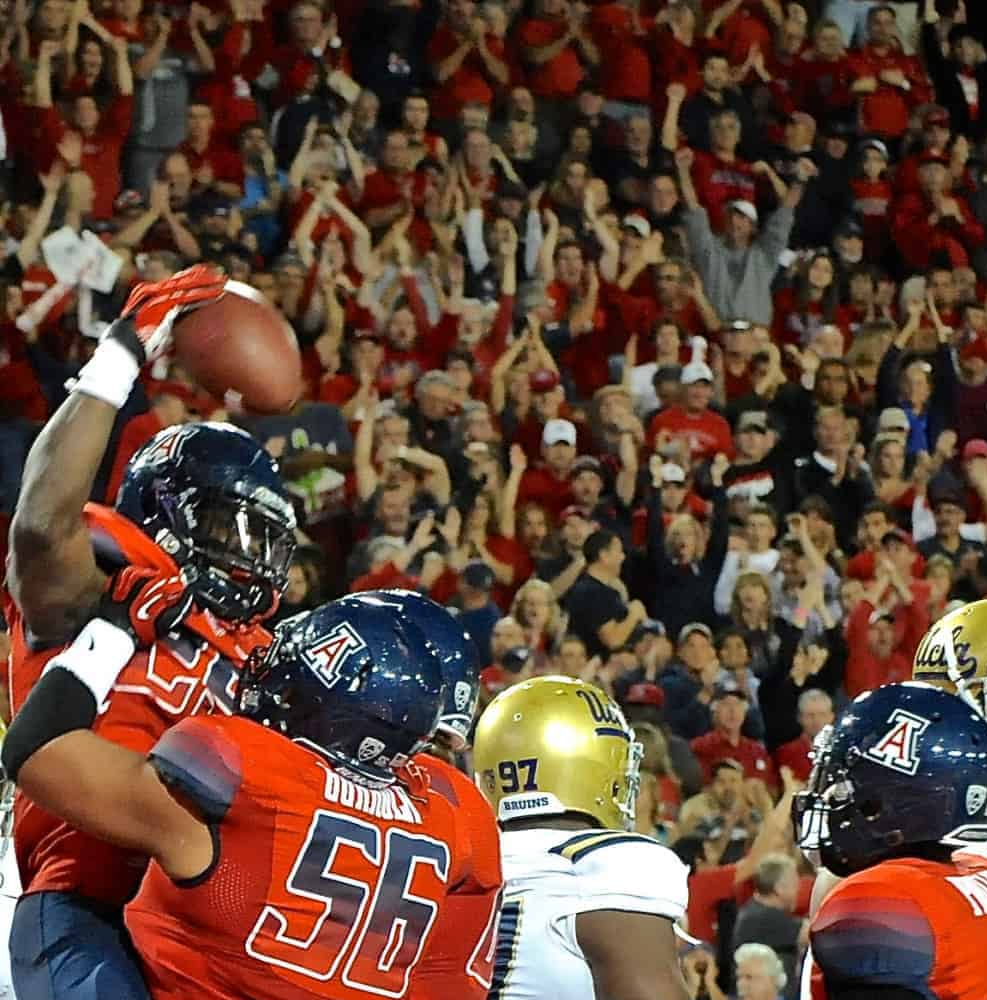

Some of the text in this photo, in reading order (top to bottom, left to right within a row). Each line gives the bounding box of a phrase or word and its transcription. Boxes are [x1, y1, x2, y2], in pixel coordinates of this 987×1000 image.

[302, 622, 366, 687] A
[862, 709, 930, 775] A
[498, 758, 538, 793] 97
[503, 797, 549, 811] BRUINS
[245, 808, 451, 998] 56
